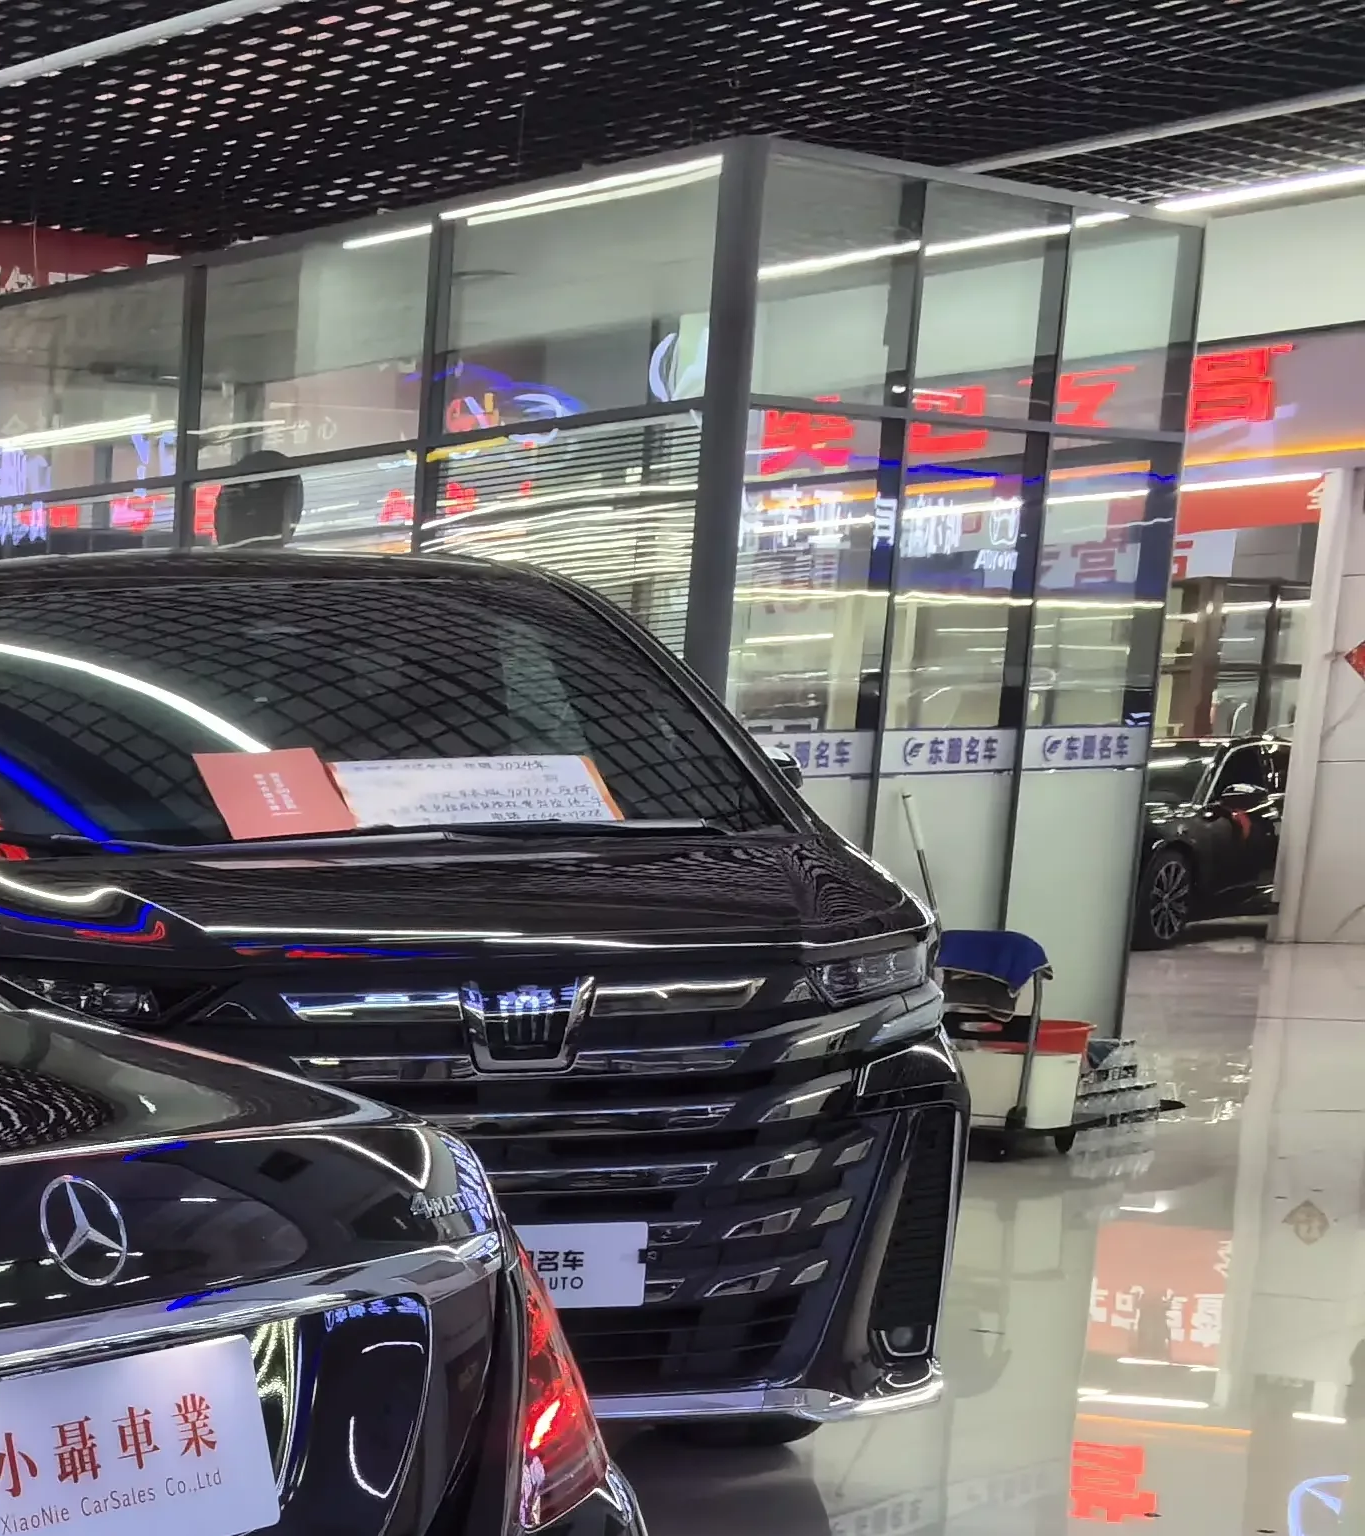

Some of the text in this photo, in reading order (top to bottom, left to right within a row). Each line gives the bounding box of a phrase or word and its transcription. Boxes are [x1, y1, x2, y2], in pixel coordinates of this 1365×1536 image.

[526, 1250, 584, 1272] 名车
[540, 1276, 584, 1290] UTO
[0, 1468, 223, 1536] XiaoNie CarSales Co.,Ltd
